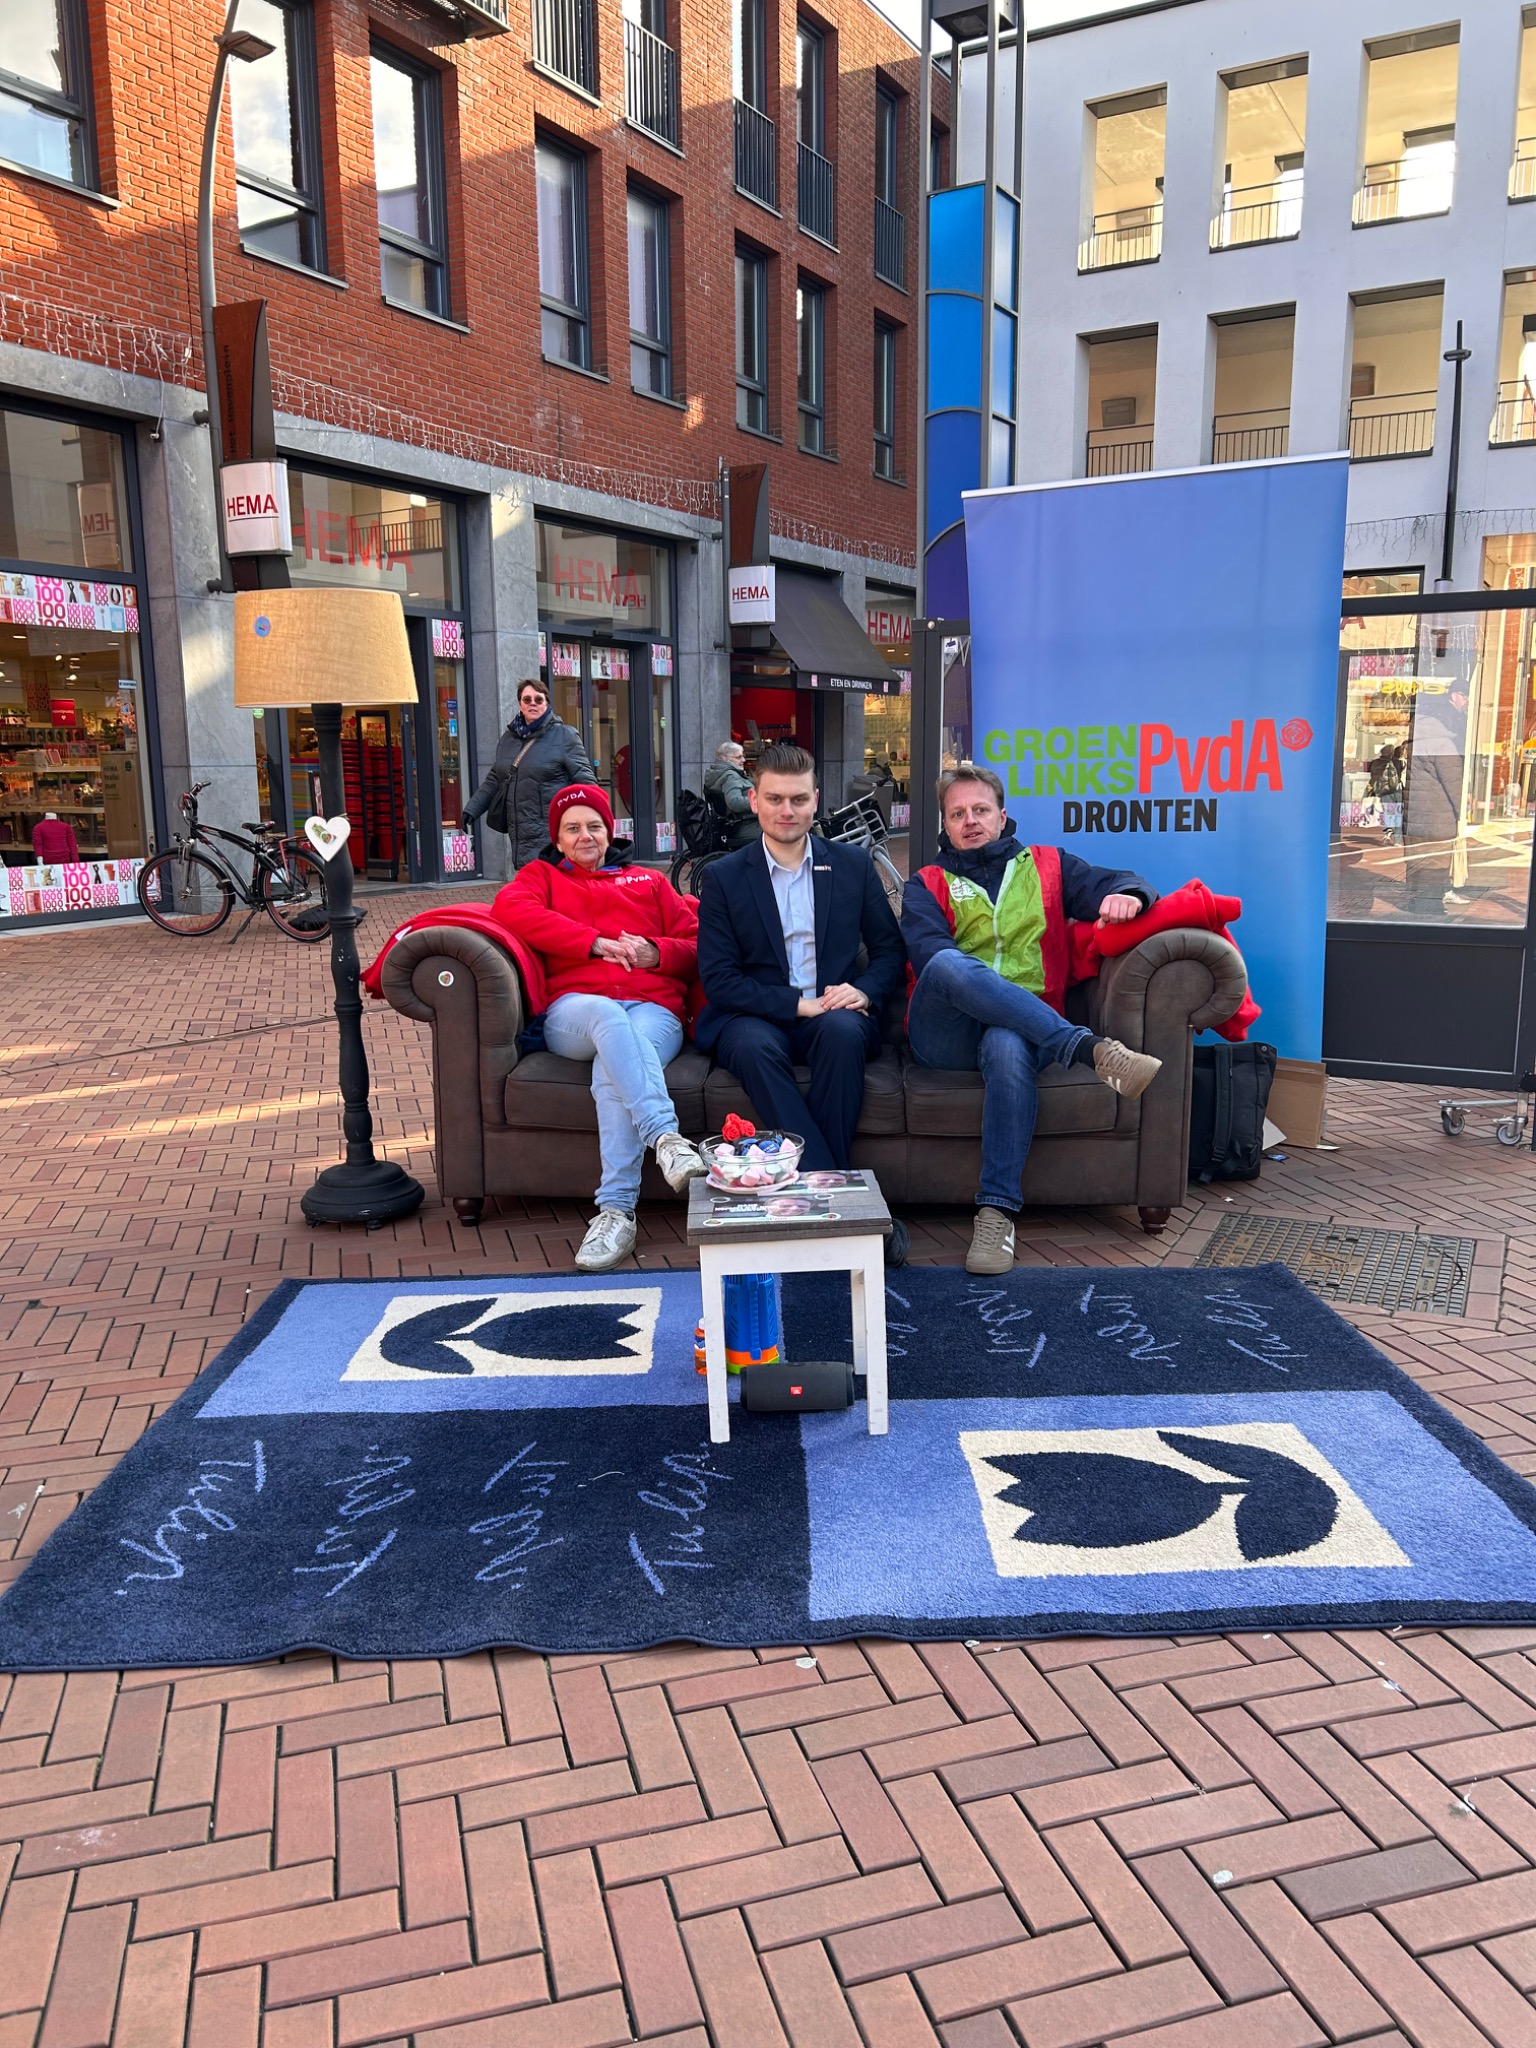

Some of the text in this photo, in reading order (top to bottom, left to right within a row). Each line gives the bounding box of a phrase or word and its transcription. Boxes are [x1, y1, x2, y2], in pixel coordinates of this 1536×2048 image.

[227, 494, 279, 518] HEMA
[292, 508, 414, 575] HEMA
[35, 585, 65, 602] 100
[554, 551, 640, 608] HEMA
[732, 586, 769, 600] HEMA
[36, 601, 65, 620] 100
[867, 610, 911, 645] HEMA
[830, 678, 873, 690] ETEN EN DRINKEN
[983, 724, 1137, 763] GROEN
[1138, 718, 1284, 794] PvdA
[1007, 761, 1136, 797] LINKS
[1062, 798, 1218, 833] DRONTEN
[63, 872, 90, 888] 100
[64, 887, 91, 903] 100
